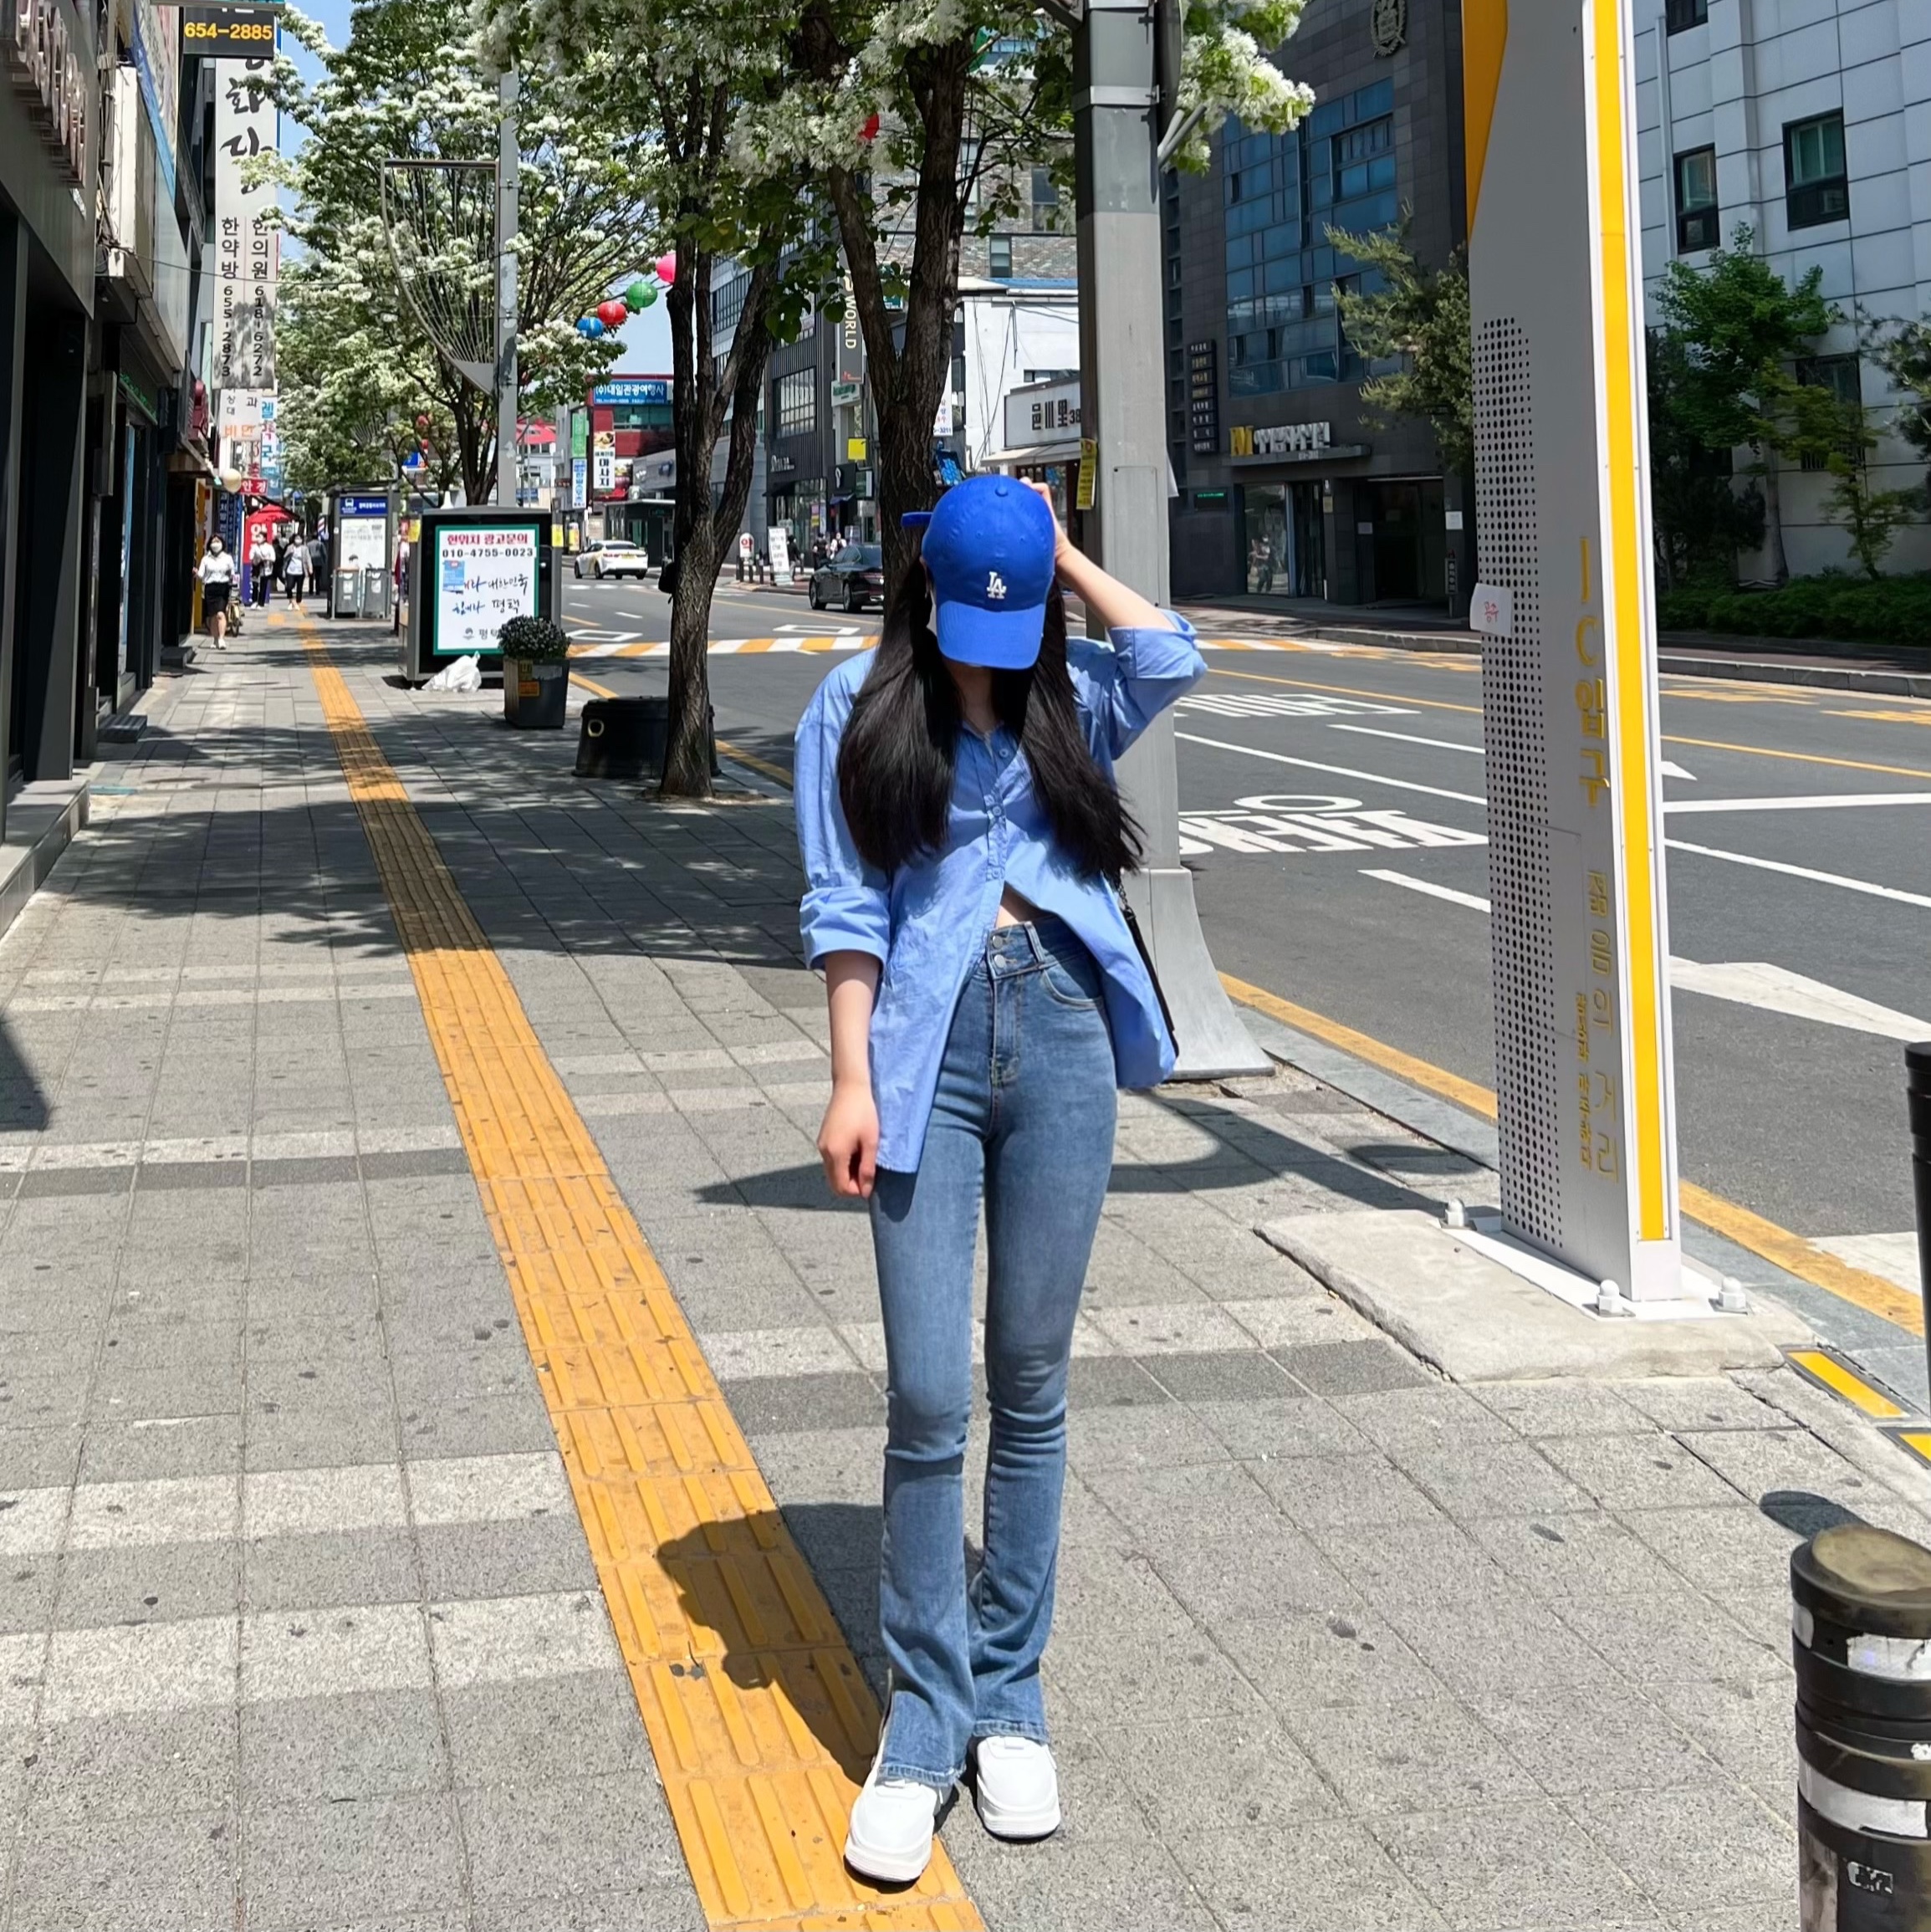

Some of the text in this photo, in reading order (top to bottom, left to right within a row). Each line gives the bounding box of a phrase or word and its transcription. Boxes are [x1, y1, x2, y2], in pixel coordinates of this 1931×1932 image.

[184, 22, 273, 40] 654-2885
[221, 59, 273, 195] 화당
[221, 217, 240, 376] 한약방 655-2873
[251, 217, 269, 376] 한의원 618-6272
[845, 294, 857, 350] WORLD
[598, 457, 610, 487] 마사지
[442, 547, 534, 559] 010-4755-0023
[447, 533, 529, 546] 현위치 광고문의
[488, 574, 529, 596] 대한민국
[986, 570, 1007, 600] LA
[491, 598, 520, 615] 평택
